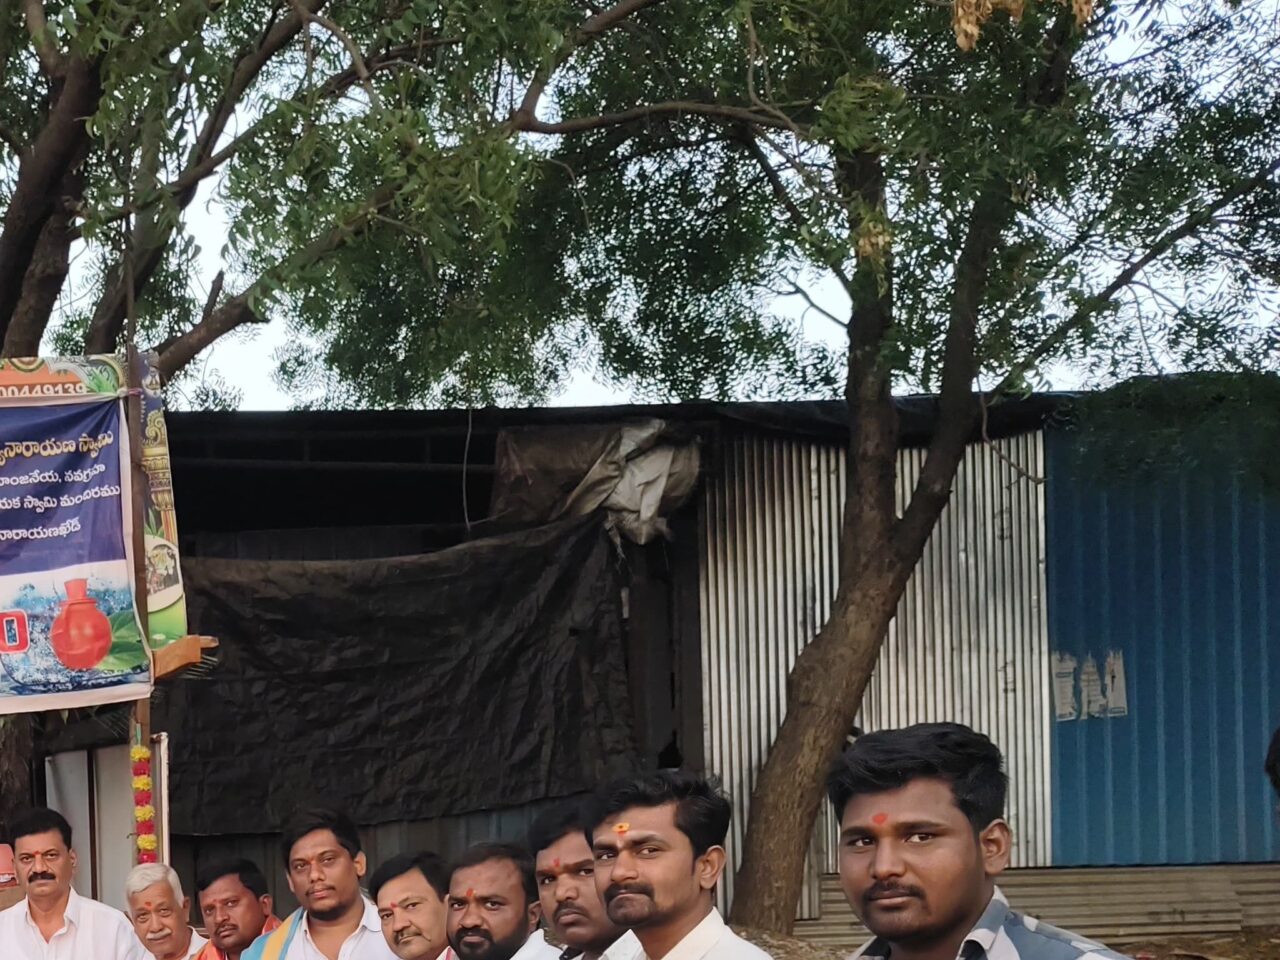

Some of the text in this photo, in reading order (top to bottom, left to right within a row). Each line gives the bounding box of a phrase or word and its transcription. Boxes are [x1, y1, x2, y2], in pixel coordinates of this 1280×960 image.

[78, 430, 114, 458] స్వామి
[24, 494, 58, 513] స్వామి
[60, 485, 120, 506] మందిరము
